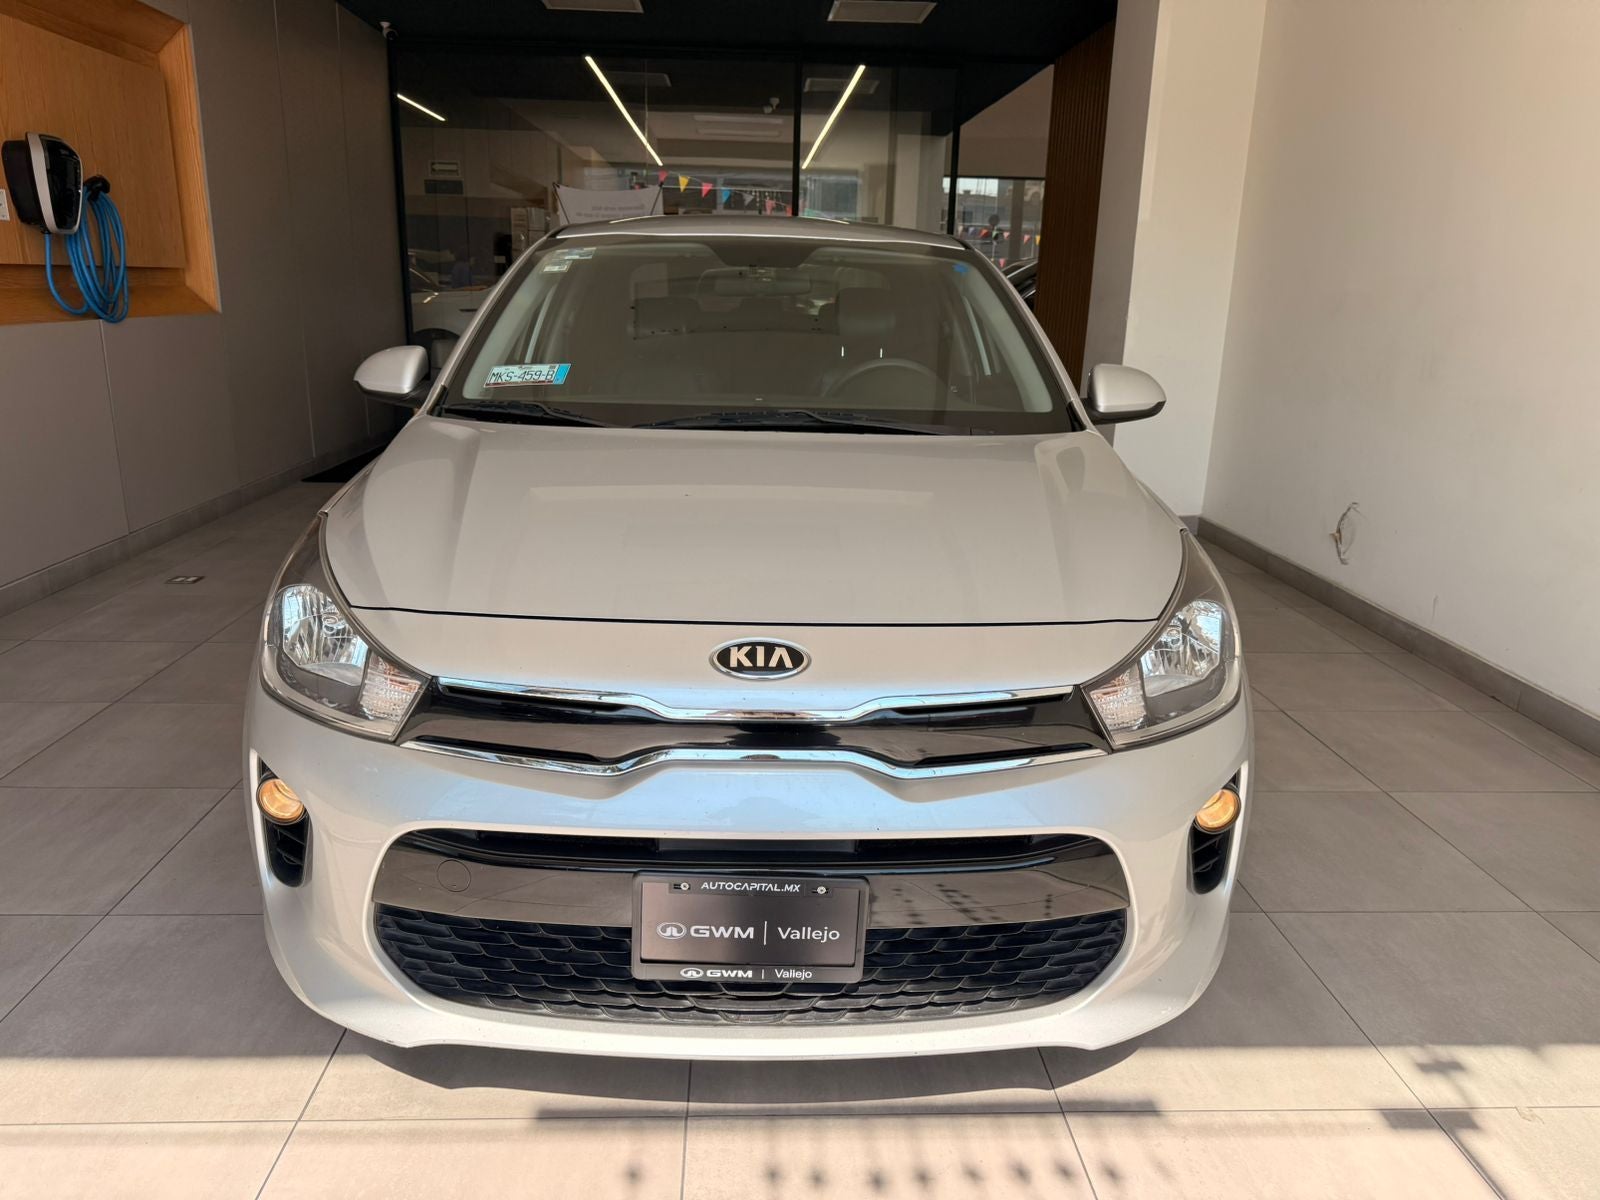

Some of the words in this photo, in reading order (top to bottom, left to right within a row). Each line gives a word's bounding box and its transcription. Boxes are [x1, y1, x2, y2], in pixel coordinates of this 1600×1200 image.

[489, 370, 555, 383] MKS-459-B
[729, 645, 794, 668] KIA
[700, 881, 802, 893] AUTOCAPITAL.MX
[690, 925, 755, 939] GWM
[777, 927, 841, 943] Vallejo
[706, 969, 753, 979] GWM
[774, 969, 813, 981] Vallejo
